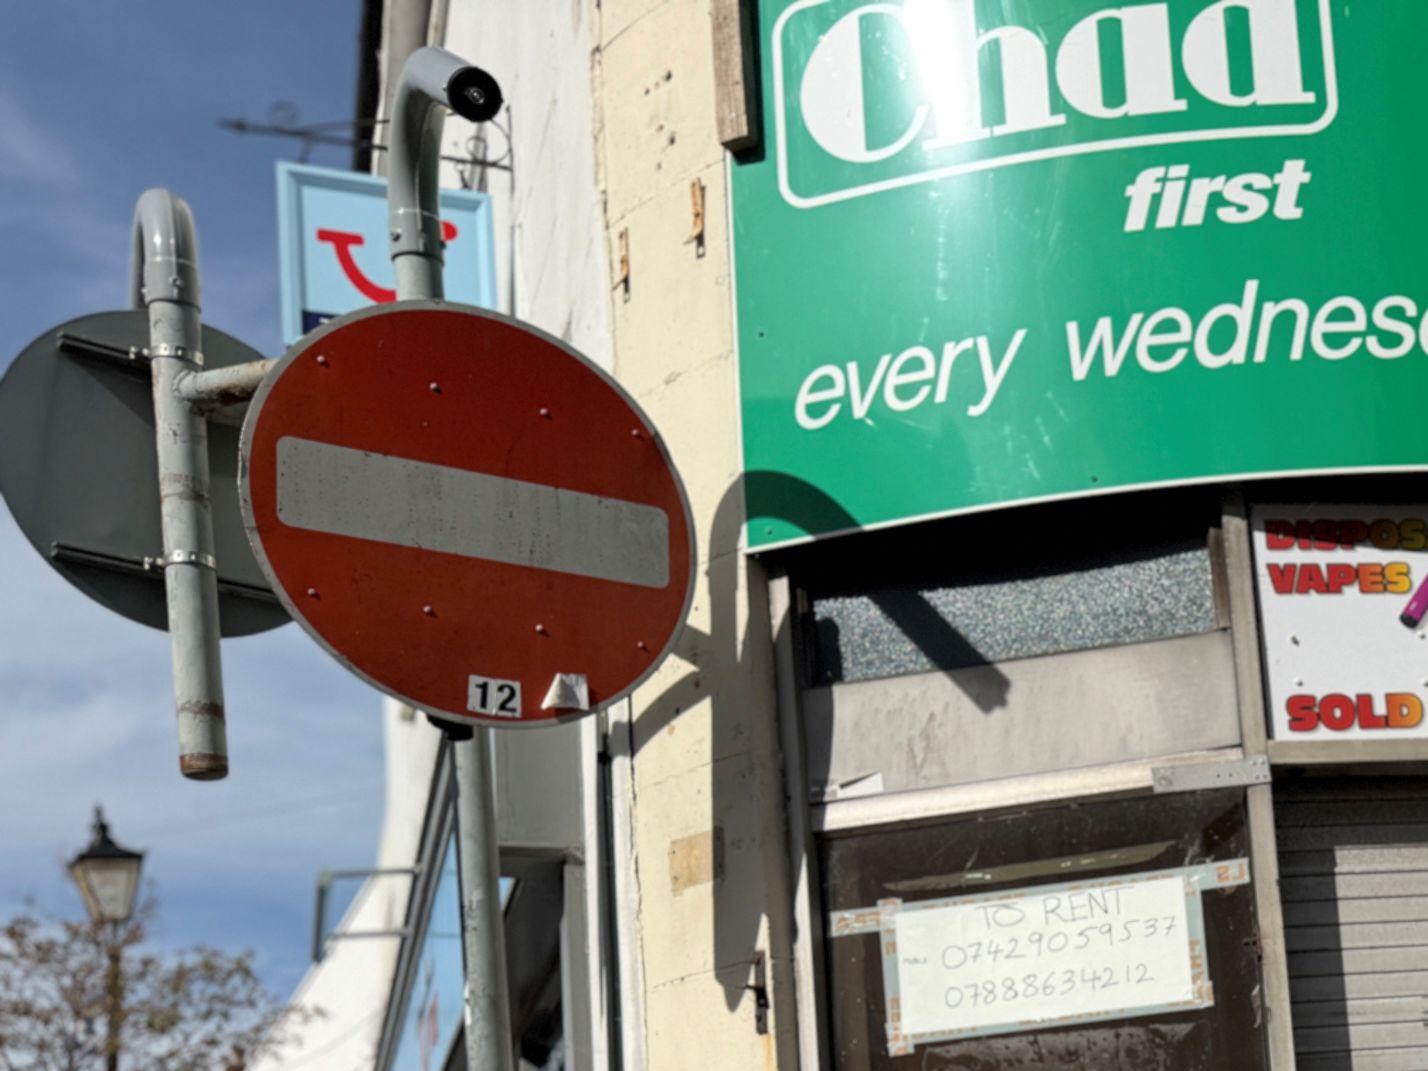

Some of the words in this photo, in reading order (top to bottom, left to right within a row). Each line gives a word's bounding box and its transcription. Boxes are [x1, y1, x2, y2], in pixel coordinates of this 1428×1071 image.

[800, 0, 1316, 163] Chad
[1123, 159, 1311, 233] first
[794, 328, 1028, 430] every
[1265, 561, 1413, 595] VAPES
[473, 680, 518, 714] 12
[1285, 692, 1424, 733] SOLD
[973, 900, 1026, 931] TO
[1042, 884, 1136, 926] RENT
[940, 916, 1177, 970] 07429059537
[944, 962, 1155, 1010] 07888634212
